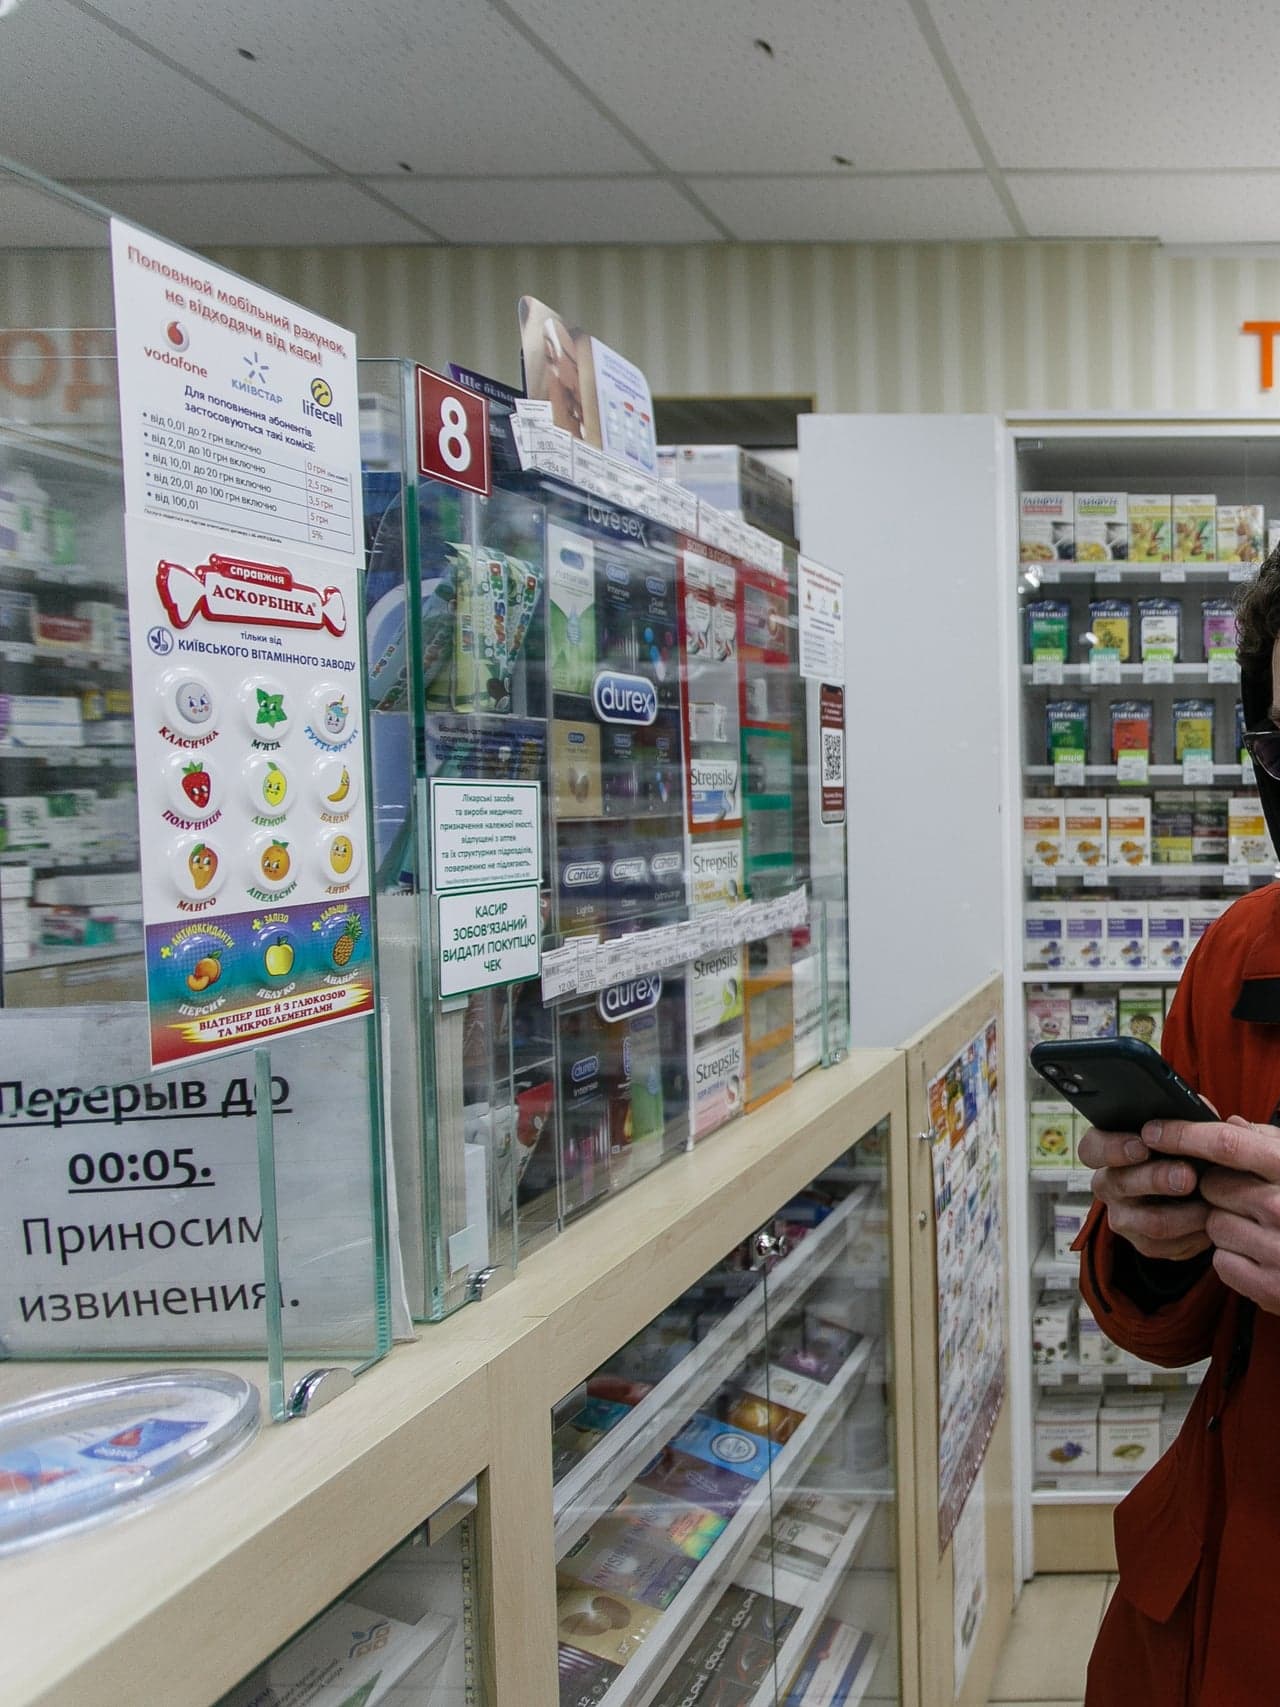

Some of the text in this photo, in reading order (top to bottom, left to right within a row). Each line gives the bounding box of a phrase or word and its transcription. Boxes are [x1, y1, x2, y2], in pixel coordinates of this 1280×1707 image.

[128, 244, 347, 357] Поповнюй мобільний рахунок,
[165, 289, 322, 365] не відходячи від каси!
[144, 346, 208, 378] vodafone
[184, 403, 263, 435] застосовуються
[267, 429, 283, 442] такі
[185, 385, 312, 437] Для поповнення абонентів
[302, 399, 342, 427] lifecell
[150, 413, 262, 455] від 0,01 до 2 грн включно
[438, 397, 471, 472] 8
[152, 433, 266, 474] від 2,01 до 10 грн включно
[152, 453, 272, 493] від 10,01 до 20 грн включно
[154, 473, 277, 512] від 20,01 до 100 грн включно
[155, 493, 199, 511] від 100,01
[230, 566, 285, 585] справжня
[212, 585, 316, 617] АСКОРБІНКА
[178, 638, 356, 671] КИЇВСЬКОГО ВІТАМІННОГО ЗАВОДУ
[241, 632, 282, 645] тільки від
[601, 680, 654, 714] durex
[159, 726, 220, 749] КЛАСИЧНА
[690, 768, 733, 789] Strepsils
[162, 809, 222, 830] ПОЛУНИЦЯ
[251, 814, 287, 826] ЛИМОН
[693, 852, 738, 874] Strepsils
[177, 898, 216, 912] МАНГО
[247, 881, 298, 902] АПЕЛЬСИН
[475, 903, 508, 918] КАСИР
[443, 932, 537, 963] ВИДАТИ ПОКУПЦЮ
[484, 959, 502, 972] ЧЕК
[694, 951, 738, 980] Strepsils
[257, 982, 296, 998] ЯБЛУКО
[179, 997, 226, 1017] ПЕРСИК
[200, 990, 346, 1031] ВІДТЕПЕР ЩЕ Й З ГЛЮКОЗОЮ
[218, 1003, 333, 1038] ТА МІКРОЕЛЕМЕНТАМИ
[696, 1048, 740, 1084] Strepsils
[0, 1075, 290, 1128] Перерыв до
[68, 1148, 212, 1187] 00:05.
